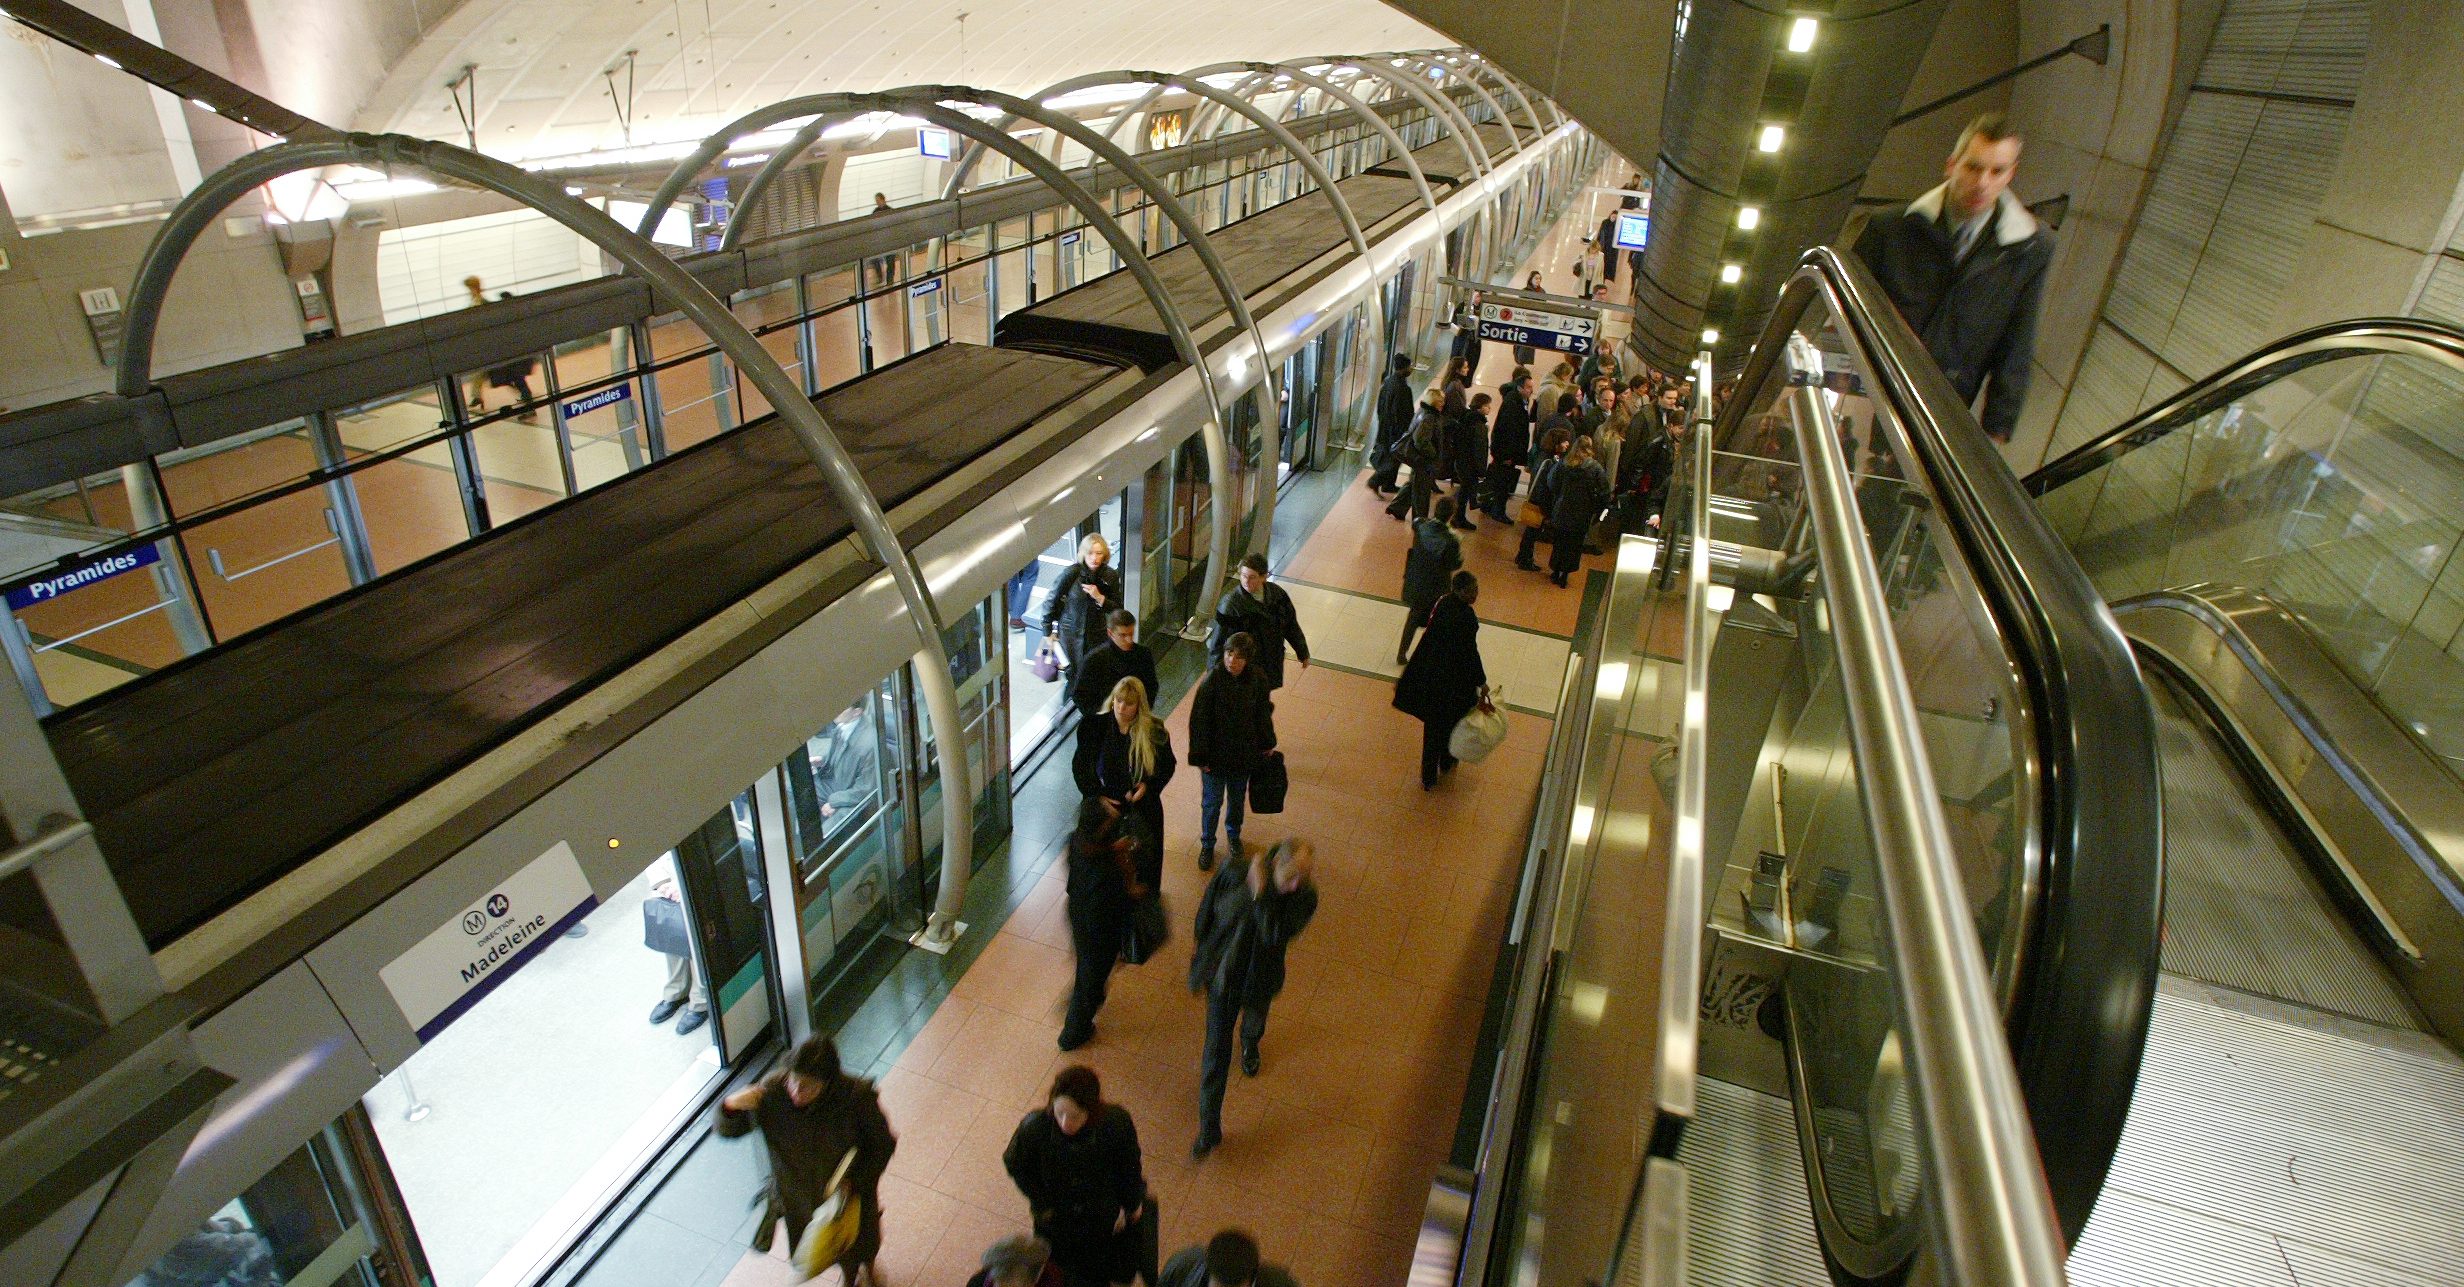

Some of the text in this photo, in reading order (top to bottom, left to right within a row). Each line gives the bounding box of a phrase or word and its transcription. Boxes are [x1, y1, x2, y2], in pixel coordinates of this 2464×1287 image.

[1480, 322, 1529, 343] Sortie
[570, 389, 621, 415] Pyramides
[29, 552, 137, 598] Pyramides
[488, 895, 507, 916] 14
[477, 916, 516, 947] DIRECTION
[460, 914, 546, 983] Madeleine
